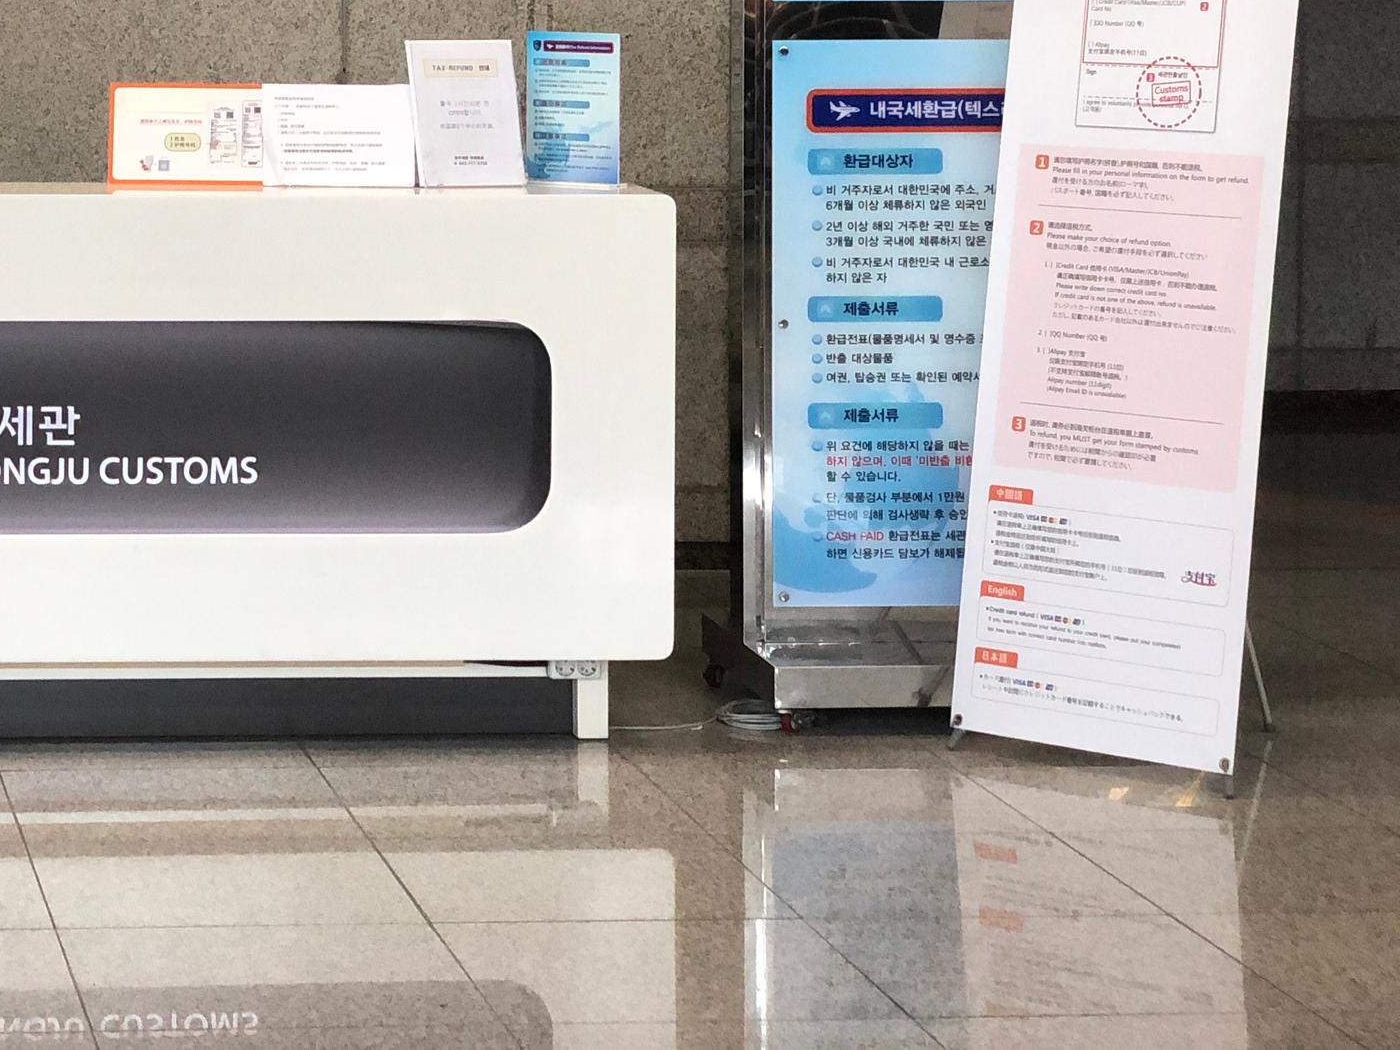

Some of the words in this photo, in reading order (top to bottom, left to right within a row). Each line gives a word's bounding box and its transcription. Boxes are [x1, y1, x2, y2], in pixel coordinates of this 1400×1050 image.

[1155, 85, 1188, 94] Customs
[1159, 94, 1184, 102] stamp
[870, 100, 1004, 119] 내국세환급(텍스
[843, 154, 913, 169] 환급대상자
[1039, 157, 1045, 168] 1
[826, 186, 836, 196] 비
[841, 185, 894, 196] 거주자로서
[898, 185, 950, 196] 대한민국에
[955, 186, 979, 196] 주소,
[984, 185, 997, 196] 거
[826, 200, 853, 211] 6개월
[859, 200, 879, 211] 이상
[883, 200, 925, 211] 체류하지
[929, 200, 950, 211] 않은
[955, 200, 986, 211] 외국인
[826, 221, 843, 232] 2년
[848, 221, 868, 232] 이상
[873, 221, 894, 232] 해외
[898, 221, 929, 232] 거주한
[933, 221, 954, 232] 국민
[959, 221, 980, 232] 또는
[1033, 222, 1040, 233] 2
[826, 236, 853, 247] 3개월
[859, 236, 879, 247] 이상
[883, 236, 915, 247] 국내에
[919, 236, 961, 247] 체류하지
[966, 236, 987, 246] 않은
[826, 257, 836, 268] 비
[841, 257, 894, 268] 거주자로서
[898, 257, 939, 268] 대한민국
[945, 257, 954, 268] 내
[959, 257, 989, 267] 근로소
[826, 272, 847, 284] 하지
[852, 272, 872, 284] 않은
[877, 273, 887, 283] 자
[843, 302, 899, 316] 제출서류
[929, 333, 939, 345] 및
[944, 333, 976, 345] 영수증
[826, 353, 846, 364] 반출
[852, 353, 893, 364] 대상물품
[826, 372, 850, 384] 여권,
[855, 372, 886, 383] 탑승권
[891, 372, 911, 383] 또는
[916, 372, 947, 383] 확인된
[843, 408, 899, 423] 제출서류
[1015, 419, 1022, 430] 3
[827, 441, 836, 451] 위
[841, 440, 872, 451] 요건에
[877, 440, 919, 451] 해당하지
[923, 440, 944, 451] 않을
[949, 440, 969, 451] 때는
[827, 456, 847, 467] 하지
[852, 456, 886, 467] 않으며,
[891, 456, 912, 466] 이때
[99, 456, 258, 485] CUSTOMS
[827, 472, 836, 482] 할
[841, 472, 851, 482] 수
[856, 471, 901, 482] 있습니다.
[938, 491, 965, 502] 1만원
[827, 510, 858, 521] 판단에
[863, 510, 883, 520] 의해
[888, 509, 929, 520] 검사생략
[934, 509, 944, 520] 후
[826, 532, 856, 541] CASH
[861, 532, 884, 541] PAID
[888, 530, 941, 541] 환급전표는
[827, 548, 847, 560] 하면
[852, 548, 894, 559] 신용카드
[898, 548, 929, 559] 담보가
[1181, 570, 1217, 586] 支付宝
[988, 586, 1017, 597] English
[981, 651, 1007, 664] 日本語
